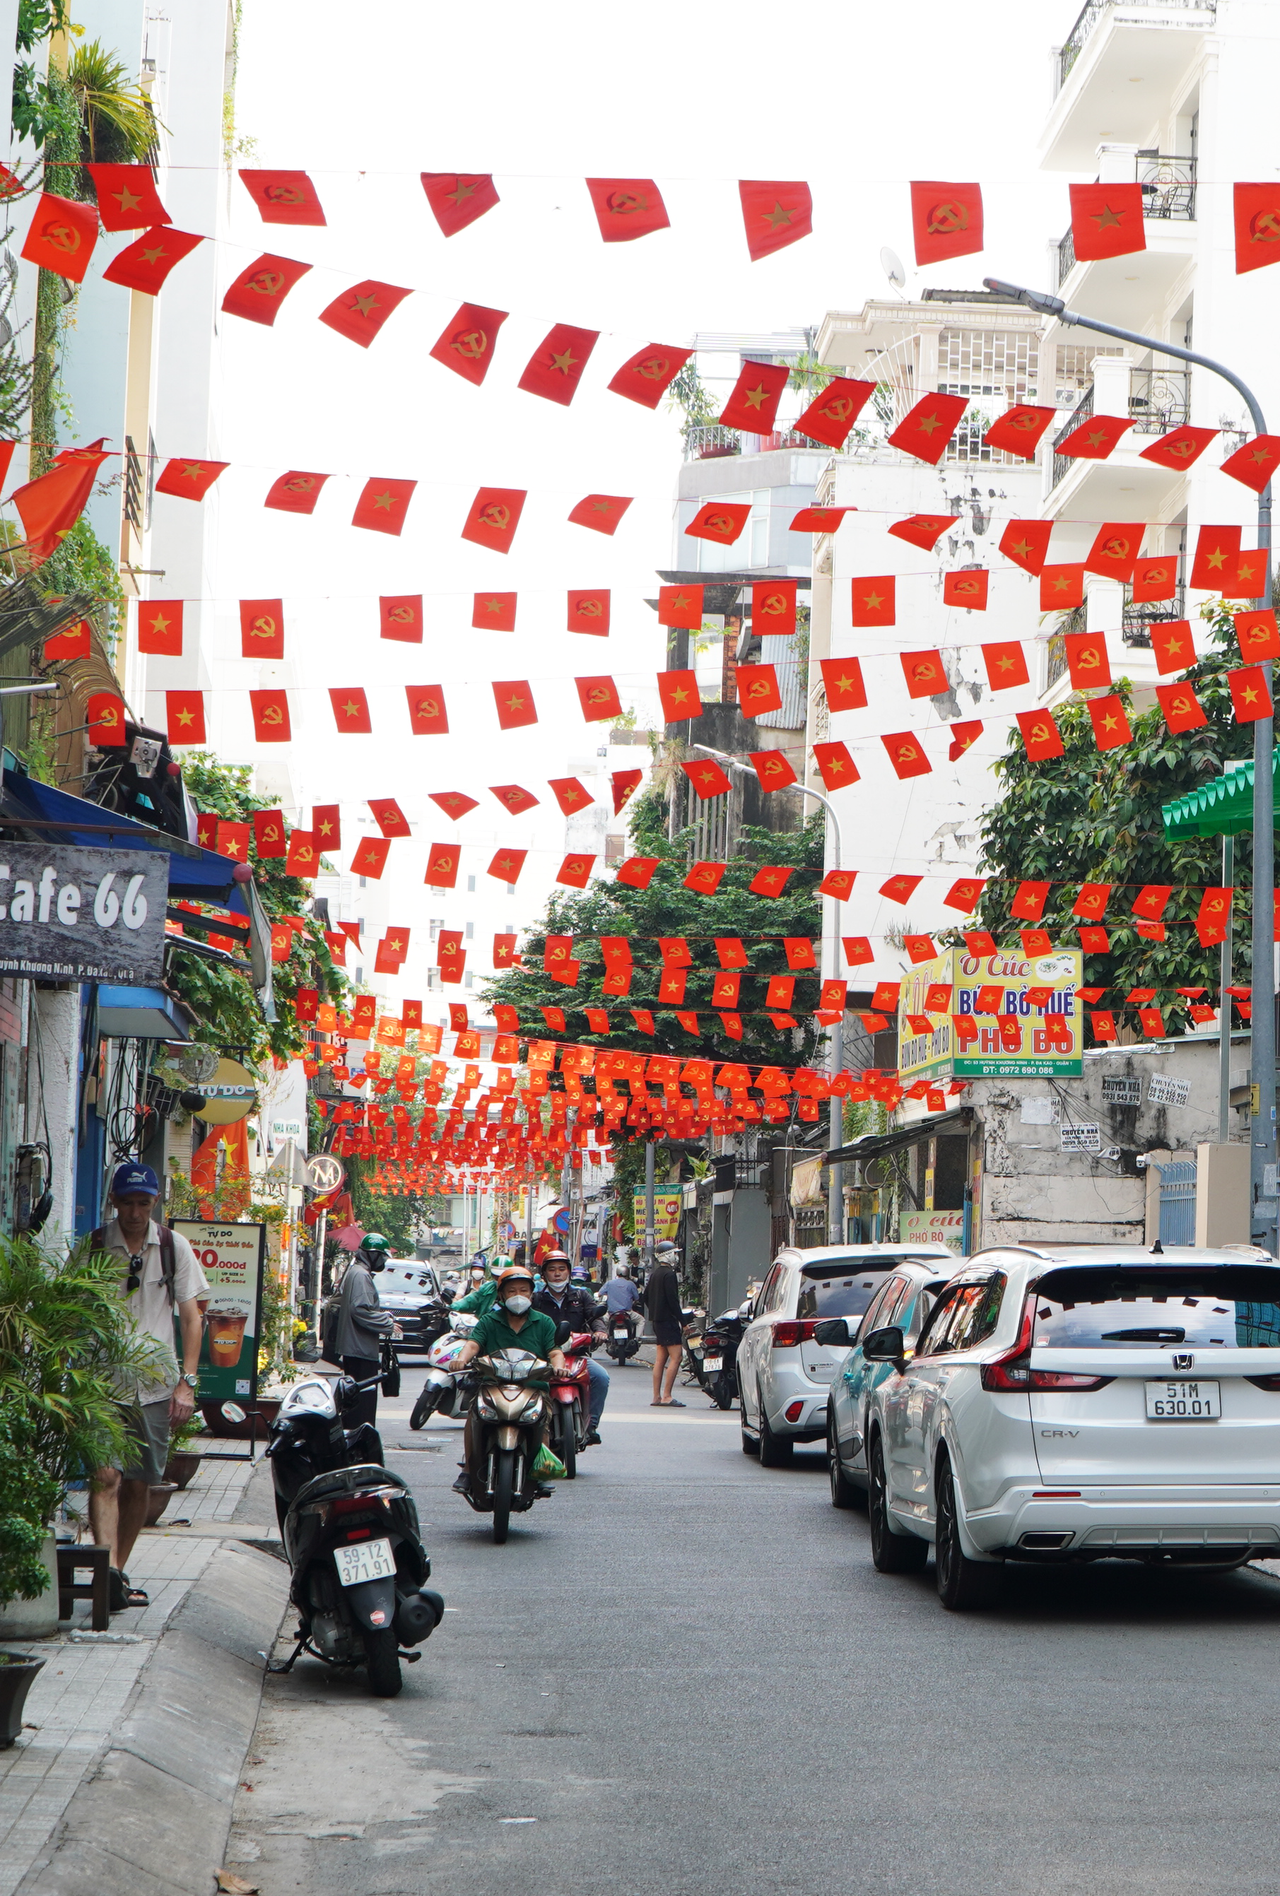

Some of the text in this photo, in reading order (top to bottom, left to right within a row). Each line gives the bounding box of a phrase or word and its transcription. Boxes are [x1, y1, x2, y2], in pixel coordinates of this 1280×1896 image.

[94, 872, 147, 930] 66
[20, 959, 52, 974] Khương
[987, 953, 1031, 977] Cúc
[983, 1066, 1054, 1074] ĐT: 0972 690 086
[222, 1085, 247, 1096] DO
[273, 1122, 300, 1135] NHA KHOA
[909, 1228, 944, 1243] PHỞ BÒ
[1167, 1383, 1199, 1399] 51M
[1154, 1400, 1211, 1416] 630.01
[1041, 1430, 1080, 1439] CR-V
[343, 1543, 384, 1565] 59-T2
[342, 1558, 391, 1583] 371.91
